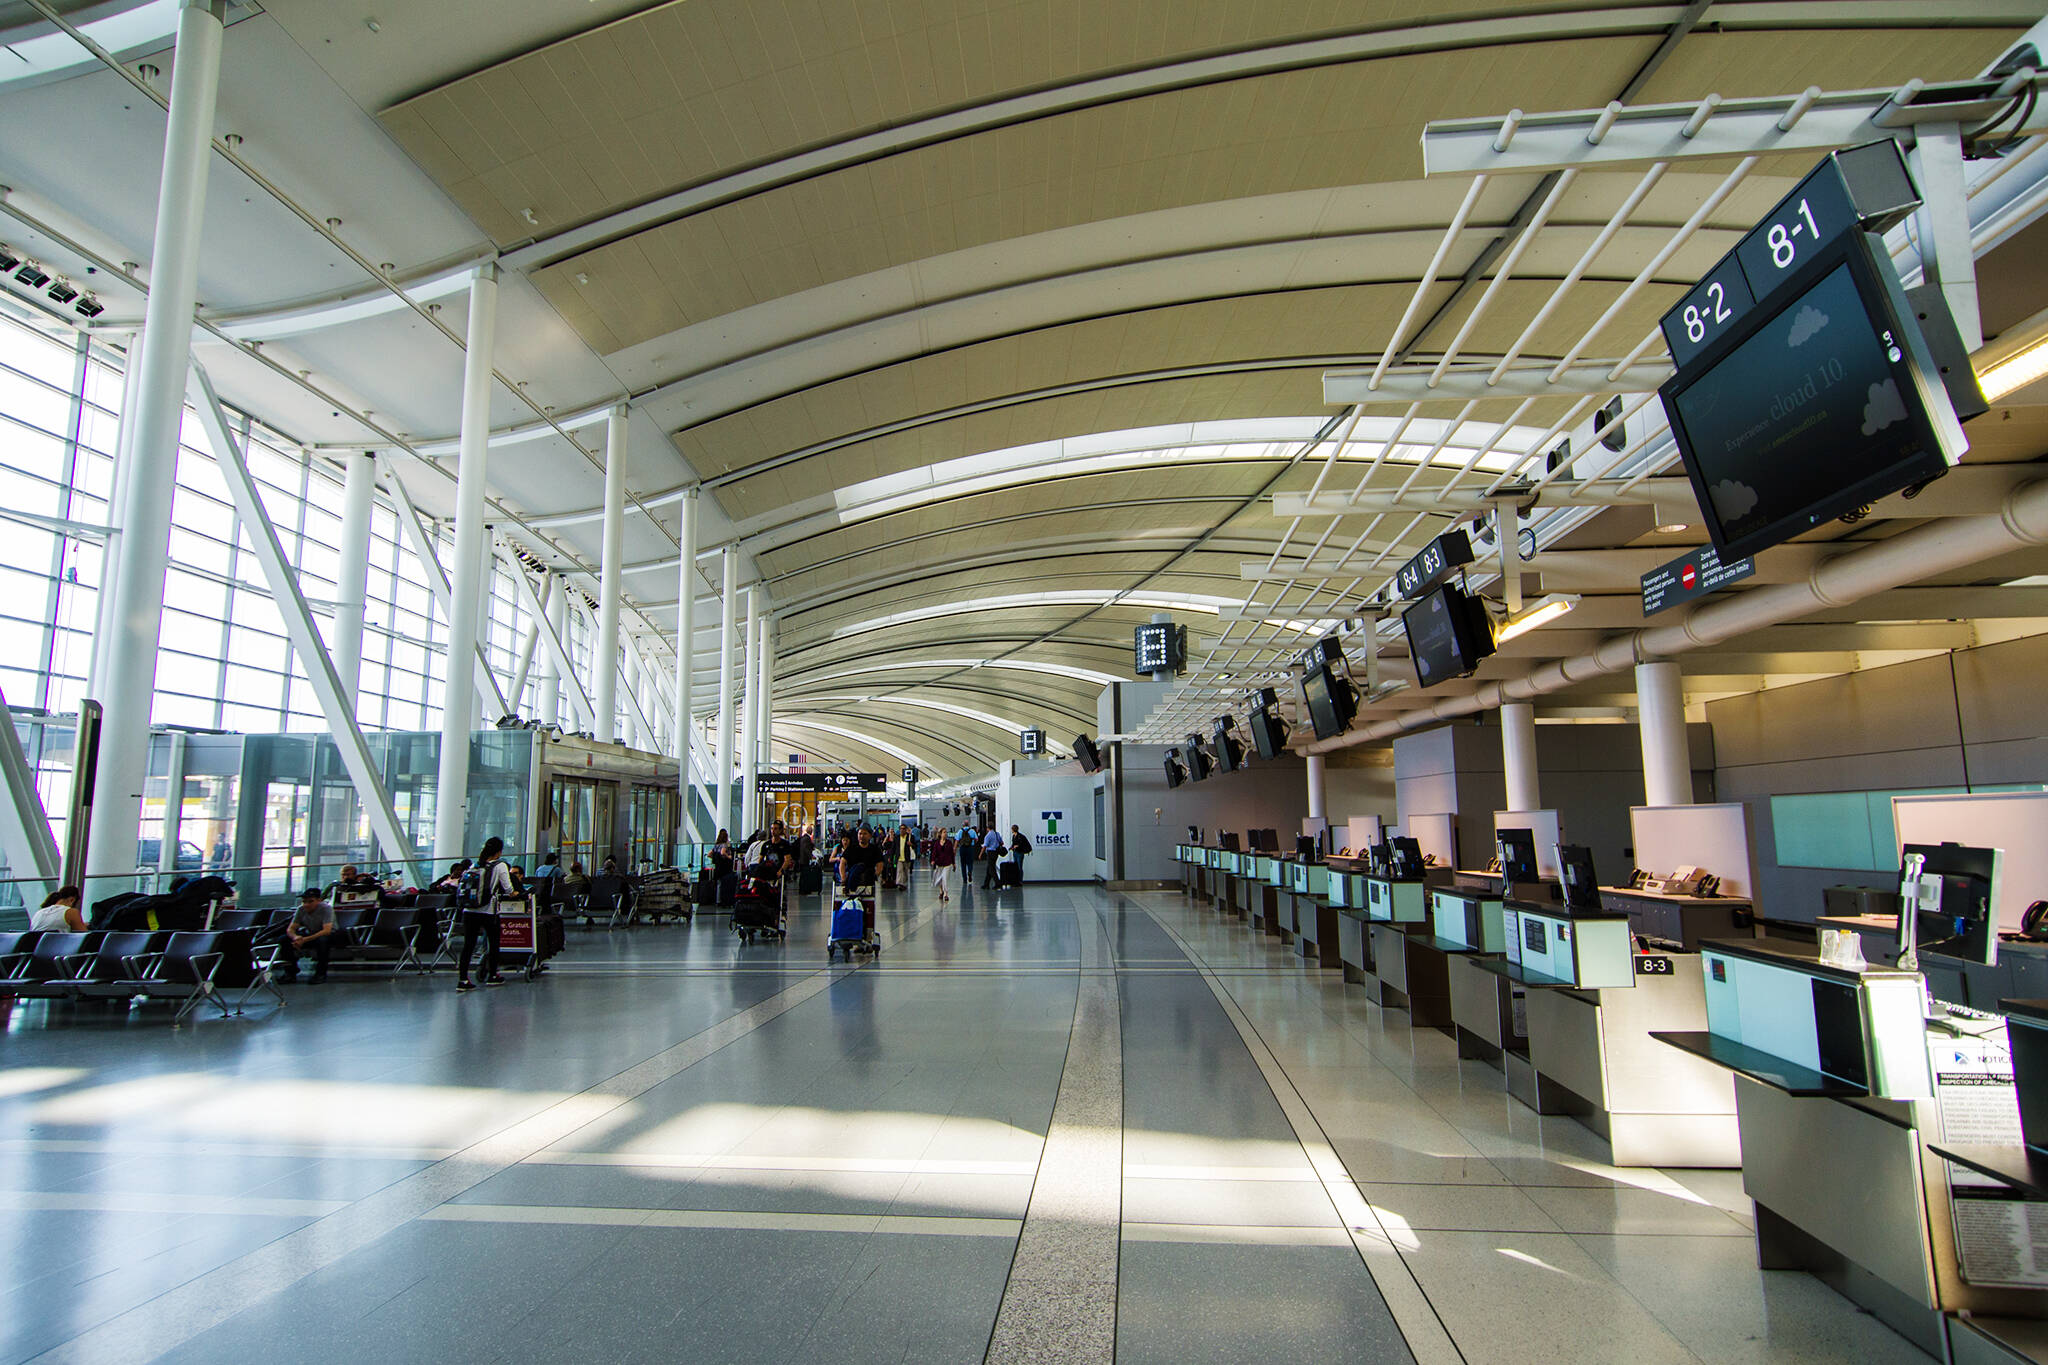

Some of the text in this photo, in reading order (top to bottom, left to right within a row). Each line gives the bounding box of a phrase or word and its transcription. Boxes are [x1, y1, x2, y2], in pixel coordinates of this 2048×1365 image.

[1767, 197, 1822, 270] 8-1
[1681, 281, 1734, 344] 8-2
[1769, 372, 1817, 421] cloud
[1423, 547, 1441, 574] 8-3
[1402, 566, 1419, 591] 8-4
[904, 769, 914, 782] 9
[1035, 834, 1070, 844] trisect
[1643, 959, 1667, 972] 8-3
